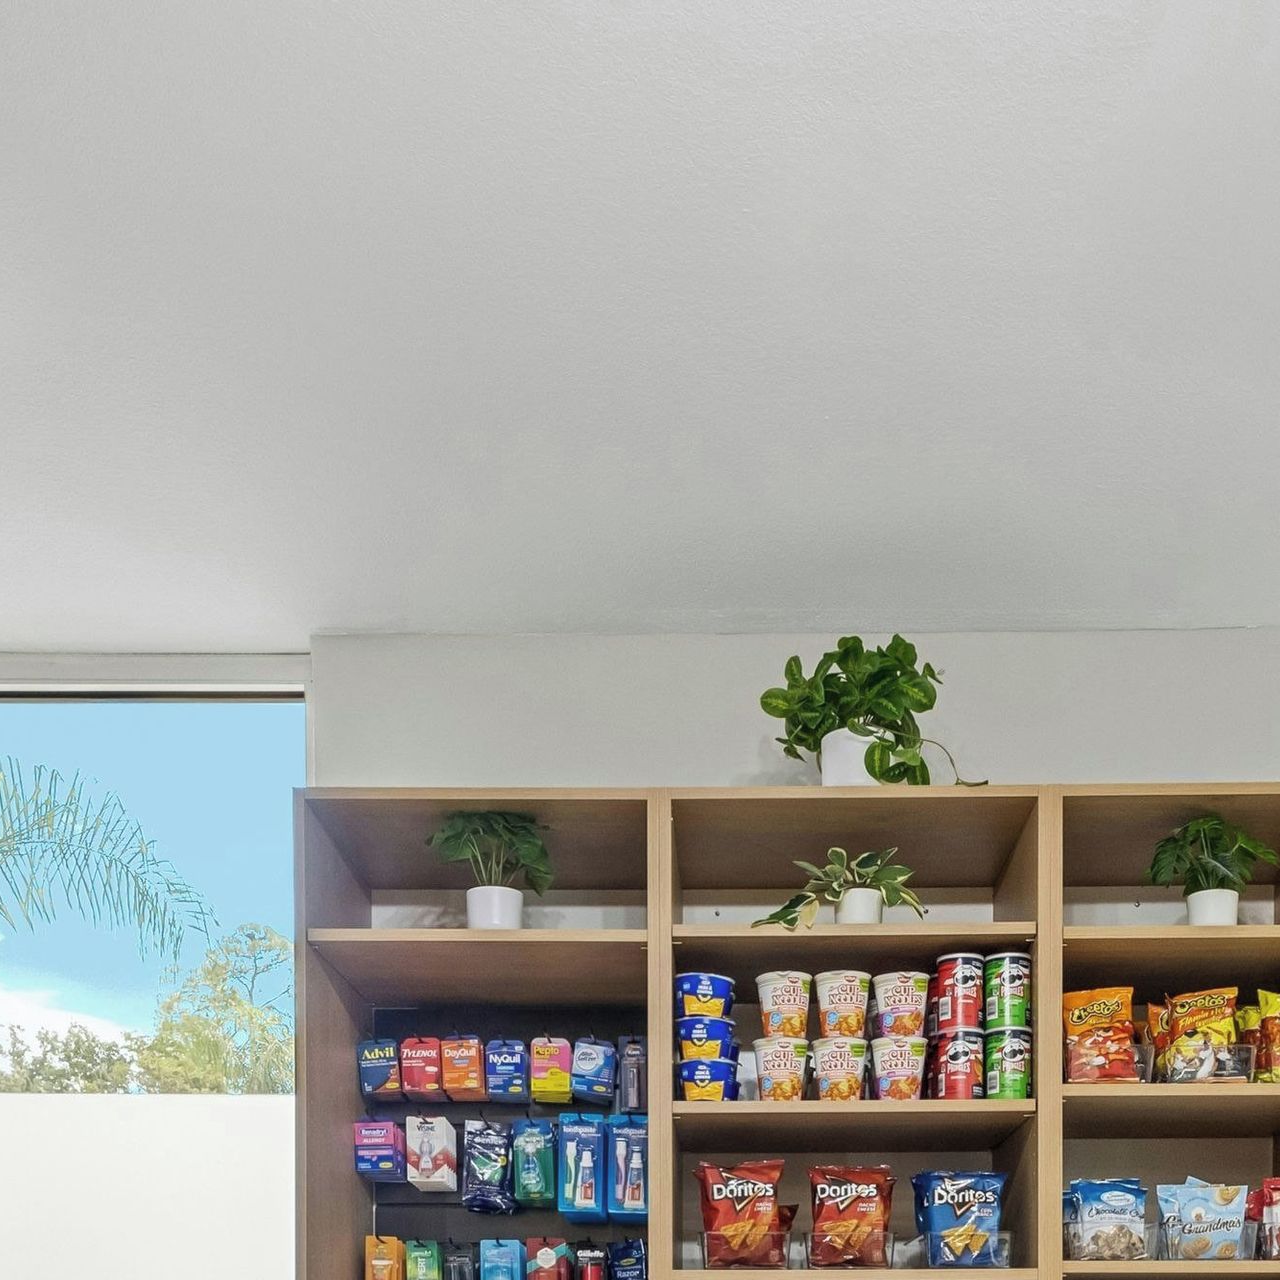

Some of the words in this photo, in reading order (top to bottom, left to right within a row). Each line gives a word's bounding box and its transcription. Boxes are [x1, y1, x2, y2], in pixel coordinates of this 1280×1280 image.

[781, 985, 803, 996] CUP
[837, 985, 859, 996] CUP
[891, 985, 916, 996] CUP
[1072, 999, 1121, 1022] Cheetos
[362, 1047, 395, 1060] Advil
[402, 1048, 438, 1058] TYLENOL
[444, 1048, 477, 1060] DayQuil
[533, 1046, 560, 1057] Pepto
[772, 1050, 794, 1061] CUP
[828, 1050, 852, 1061] CUP
[888, 1050, 913, 1061] CUP
[489, 1054, 521, 1065] NyQuil
[713, 1181, 774, 1200] Doritos
[817, 1181, 877, 1200] Doritos
[934, 1187, 995, 1205] Doritos
[1181, 1216, 1243, 1235] Grandma's
[616, 1270, 640, 1279] Razor
